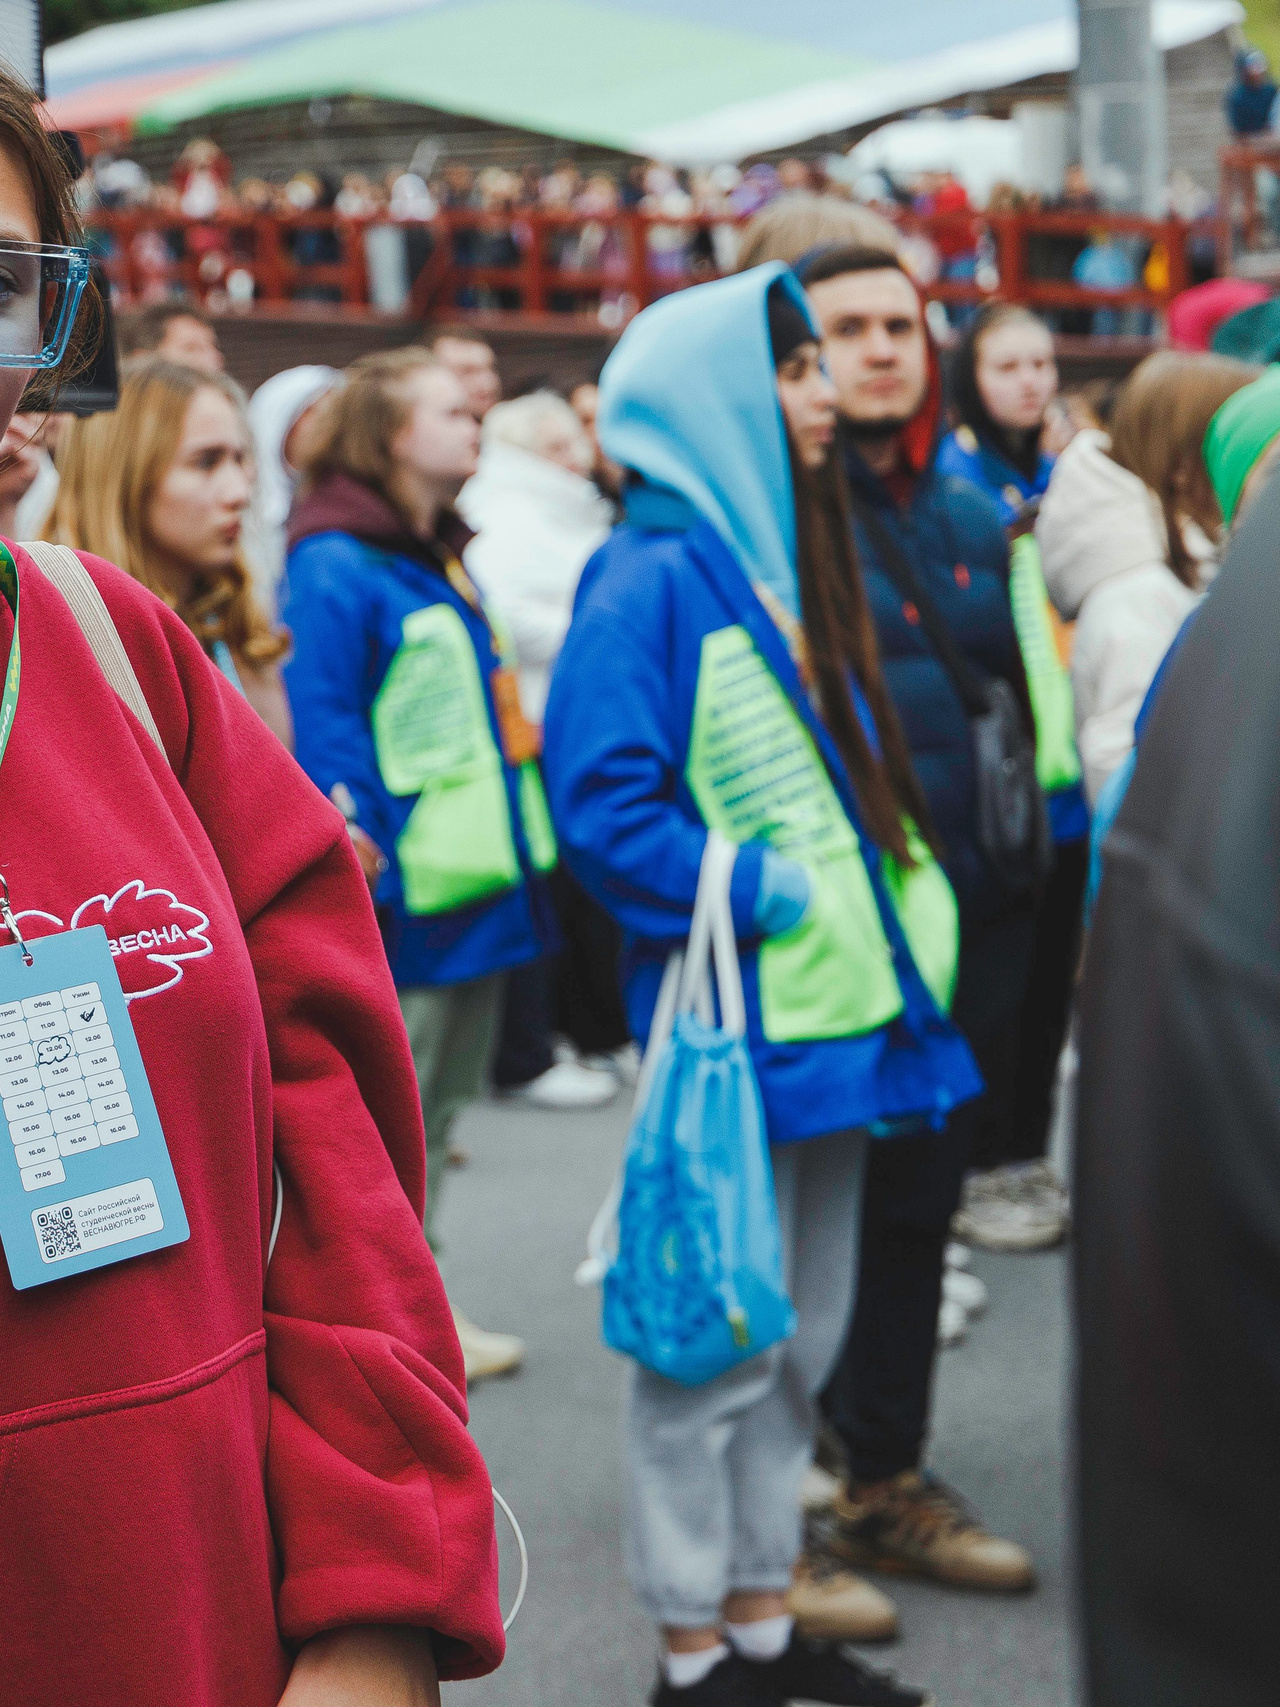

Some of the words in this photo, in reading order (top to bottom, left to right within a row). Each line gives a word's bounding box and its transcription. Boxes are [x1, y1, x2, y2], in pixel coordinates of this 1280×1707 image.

[34, 1000, 52, 1009] Обед
[72, 990, 90, 999] Ужин
[0, 1031, 16, 1040] 11.06
[40, 1021, 56, 1030] 11.06
[4, 1054, 23, 1063] 12.06
[45, 1044, 63, 1053] 12.06
[85, 1034, 101, 1043] 12.06
[10, 1077, 29, 1086] 13.06
[51, 1067, 69, 1076] 13.06
[91, 1057, 108, 1066] 13.06
[34, 1171, 52, 1180] 17.06
[78, 1207, 96, 1219] Сайт
[98, 1194, 141, 1212] Российской
[80, 1207, 132, 1228] студенческой
[133, 1203, 156, 1216] весны
[83, 1214, 147, 1238] ВЕСНАВЮГРЕ.РФ
